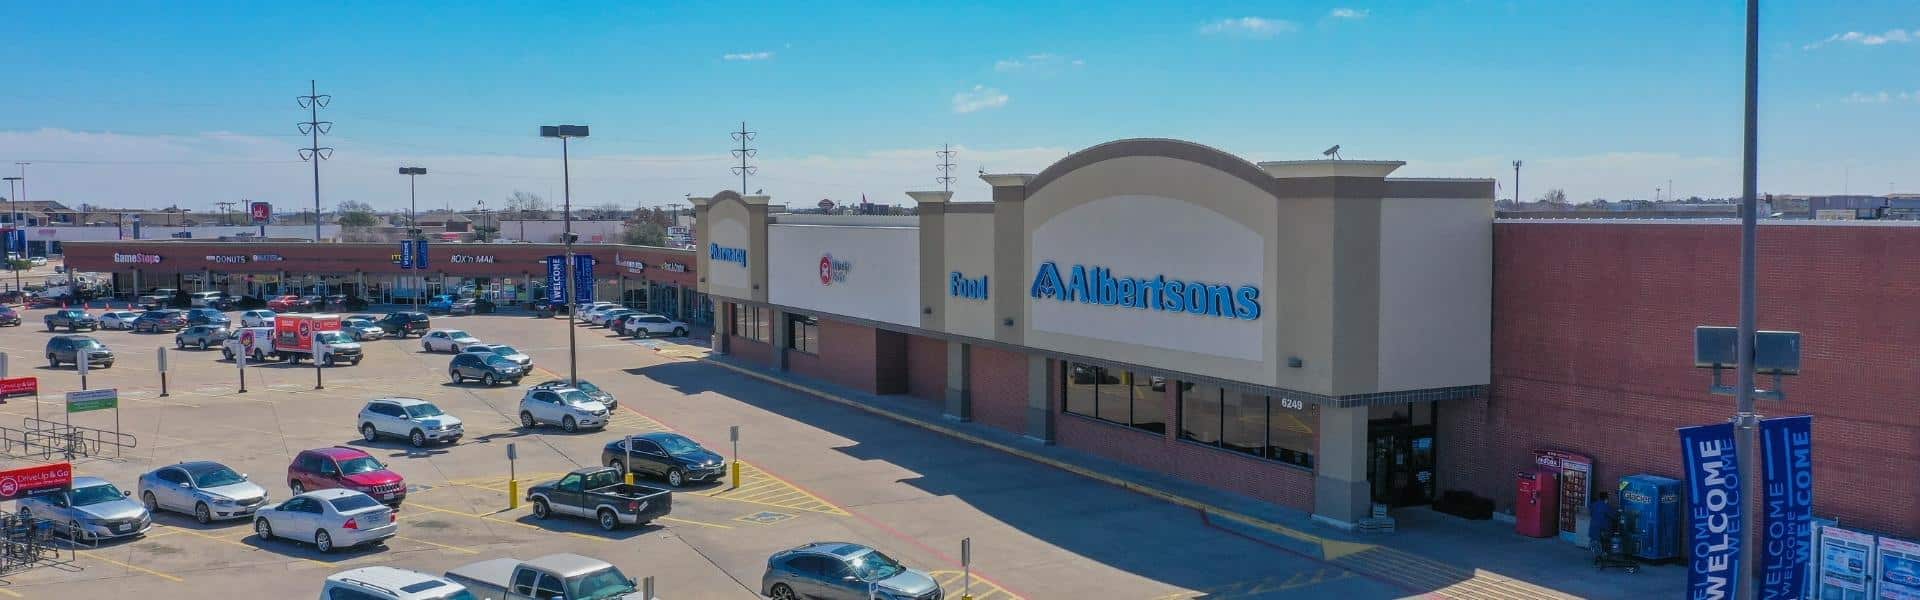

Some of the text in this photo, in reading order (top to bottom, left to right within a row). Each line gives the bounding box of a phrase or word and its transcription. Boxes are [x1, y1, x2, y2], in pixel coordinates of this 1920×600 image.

[114, 252, 158, 263] GameStop
[216, 255, 245, 264] DONUTS
[710, 242, 747, 268] Pharmacy
[552, 257, 561, 299] WELCOME
[951, 271, 987, 300] Food
[1067, 264, 1262, 321] Albertsons
[1281, 398, 1303, 410] 6249
[1720, 438, 1742, 557] WELCOME
[1793, 431, 1811, 564] WELCOME
[1781, 511, 1797, 597] WELCOME
